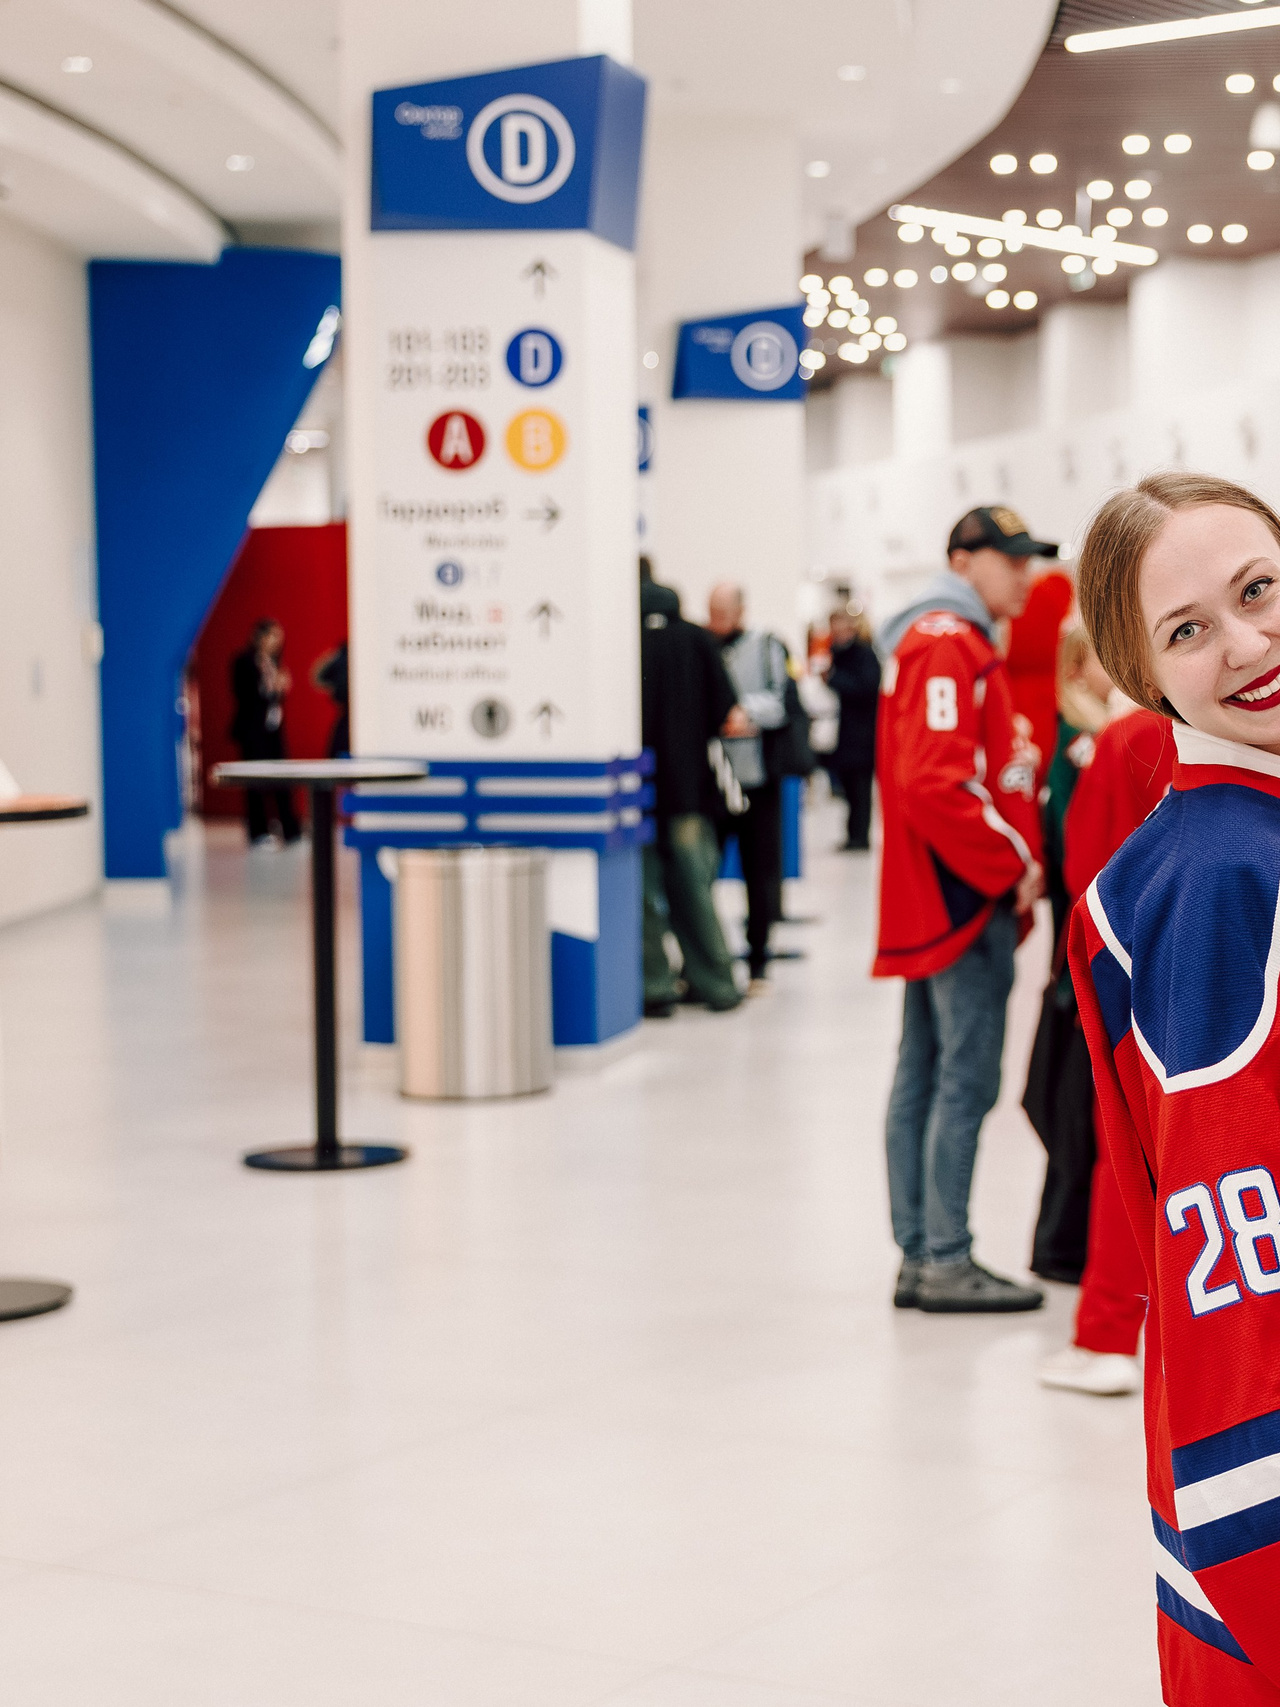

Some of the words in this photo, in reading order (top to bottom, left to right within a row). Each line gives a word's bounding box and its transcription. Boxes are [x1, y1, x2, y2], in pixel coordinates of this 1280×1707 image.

[501, 112, 547, 184] D
[519, 331, 553, 388] D
[439, 413, 474, 464] A
[926, 677, 958, 731] 8
